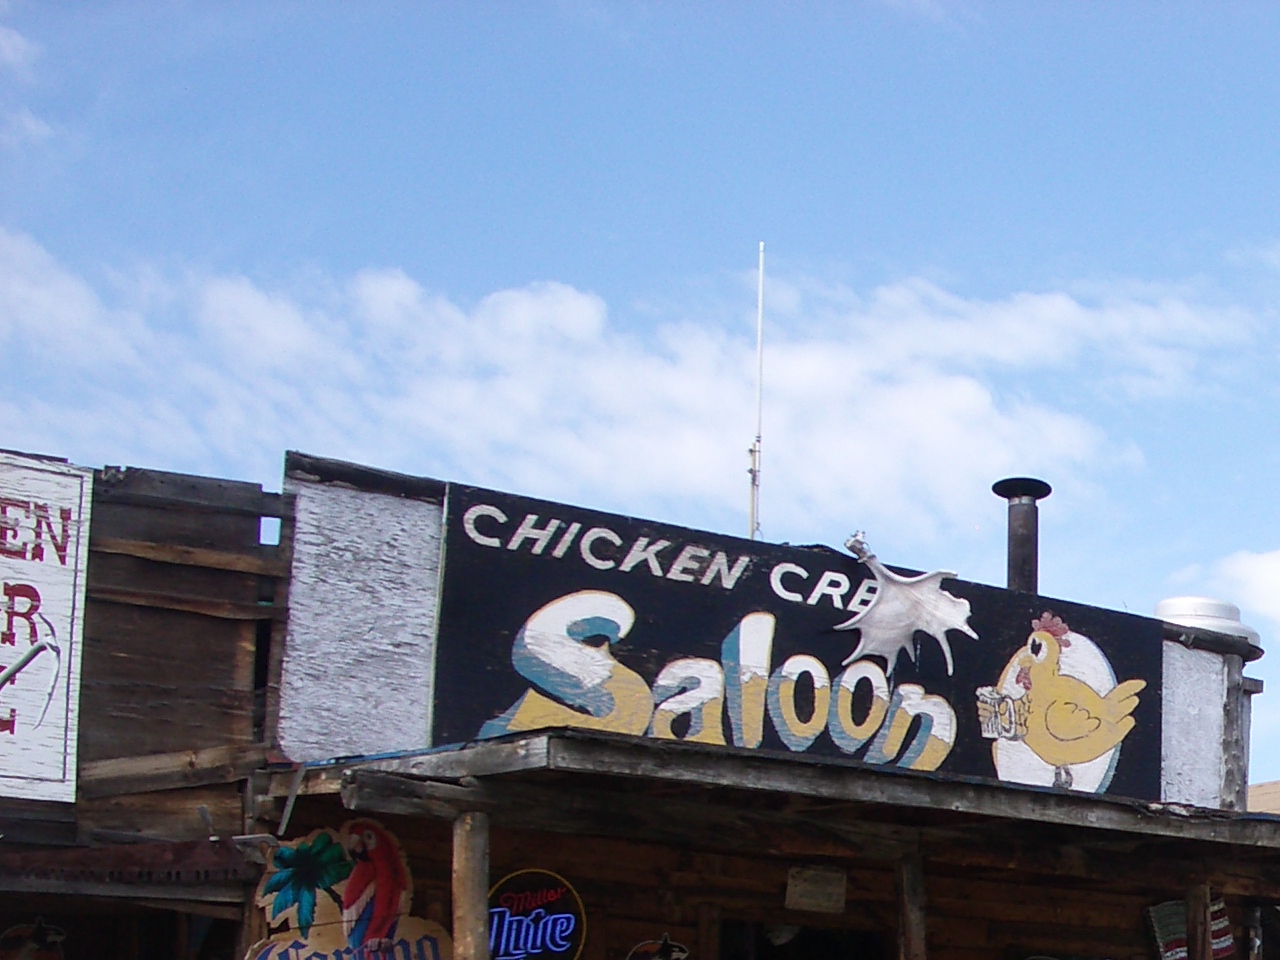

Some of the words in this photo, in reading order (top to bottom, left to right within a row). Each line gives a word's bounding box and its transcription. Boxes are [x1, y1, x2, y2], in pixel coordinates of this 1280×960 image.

[462, 504, 751, 590] CHICKEN
[769, 562, 881, 613] CRE
[478, 590, 958, 772] Saloon
[499, 886, 567, 916] Miller
